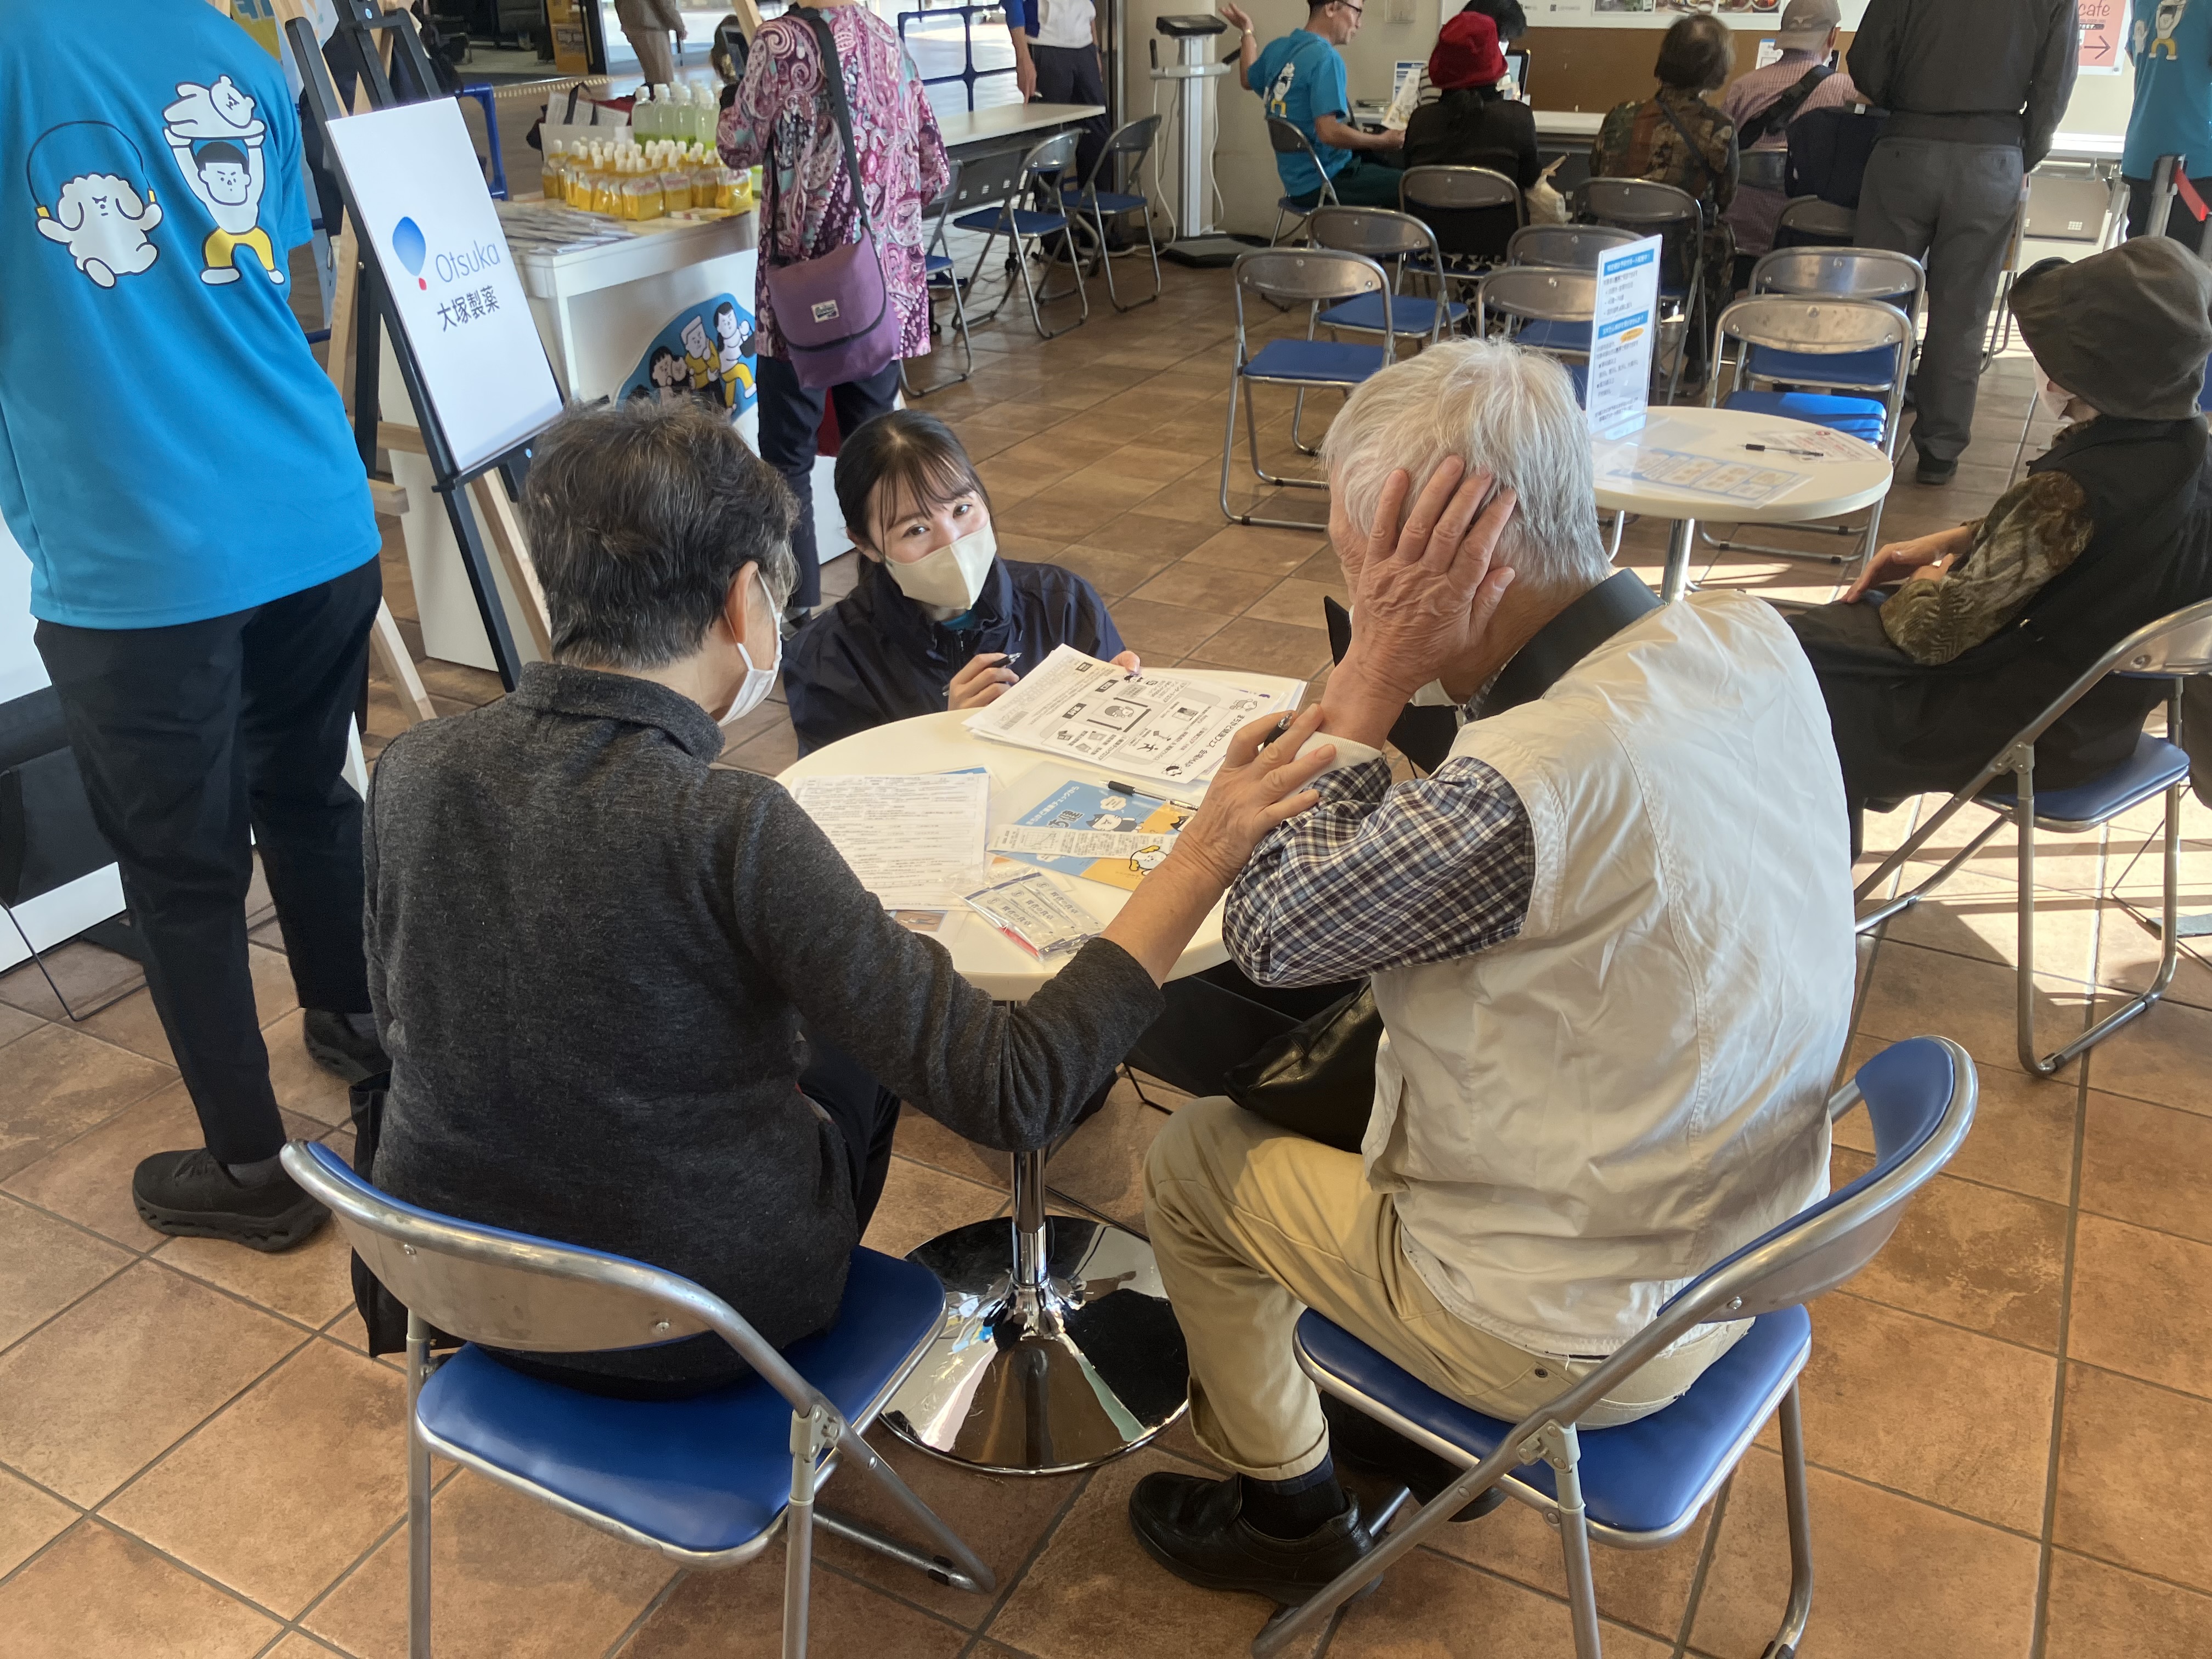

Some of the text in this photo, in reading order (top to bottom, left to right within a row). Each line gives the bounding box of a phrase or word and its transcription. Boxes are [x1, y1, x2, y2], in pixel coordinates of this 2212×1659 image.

[436, 240, 500, 283] Otsuka
[437, 285, 500, 332] 大塚製薬
[1047, 810, 1084, 828] ち健
